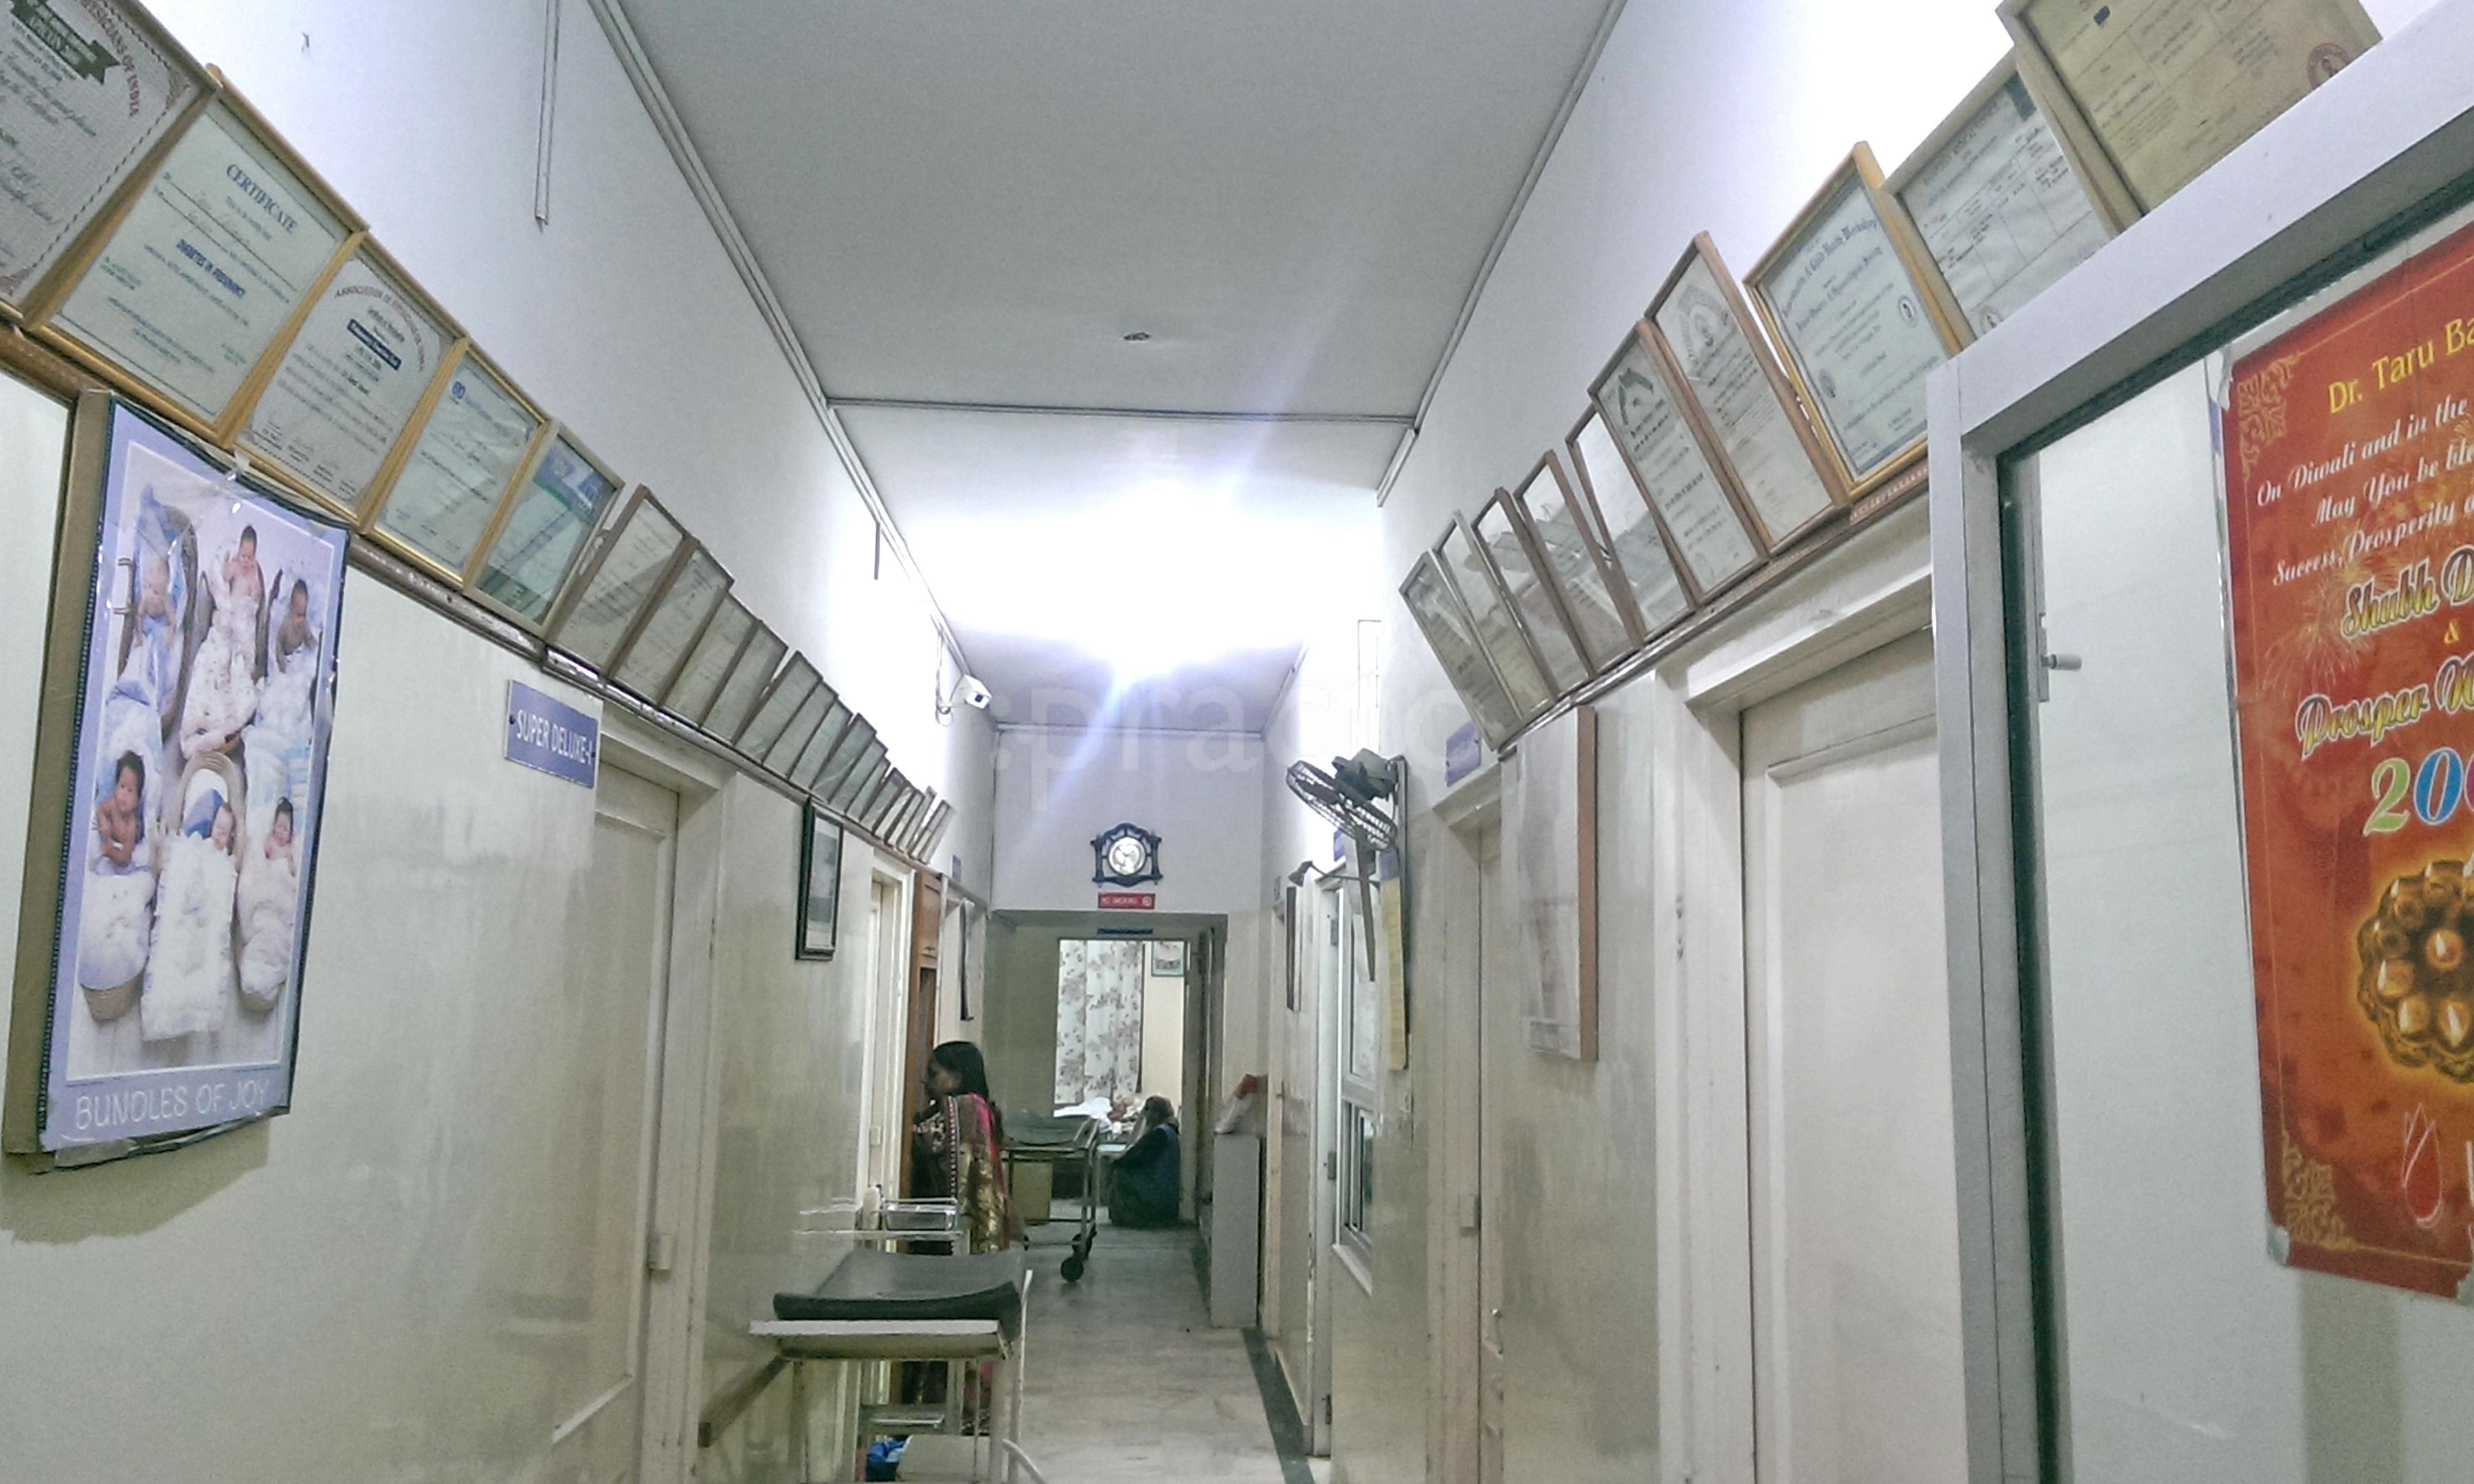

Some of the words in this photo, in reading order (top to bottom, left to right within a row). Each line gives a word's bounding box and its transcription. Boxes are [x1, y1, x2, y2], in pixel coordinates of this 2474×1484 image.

[226, 164, 298, 234] CERTIFICATE
[2328, 378, 2363, 414] Dr.
[2372, 340, 2435, 390] Taru
[2257, 480, 2282, 507] On
[2288, 442, 2357, 490] Diwali
[2361, 418, 2402, 460] and
[2407, 414, 2427, 440] in
[2434, 394, 2468, 428] the
[2315, 495, 2356, 524] May
[2363, 471, 2409, 508] You
[2417, 456, 2439, 483] be
[2341, 500, 2456, 562] Prosperity
[2340, 556, 2440, 640] Shubh
[2444, 619, 2460, 644] &
[516, 708, 550, 750] SUPER
[2295, 683, 2431, 759] Prosper
[2363, 747, 2474, 837] 20
[76, 1086, 188, 1131] BUNDLES
[195, 1083, 225, 1115] OF
[228, 1079, 270, 1111] JOY
